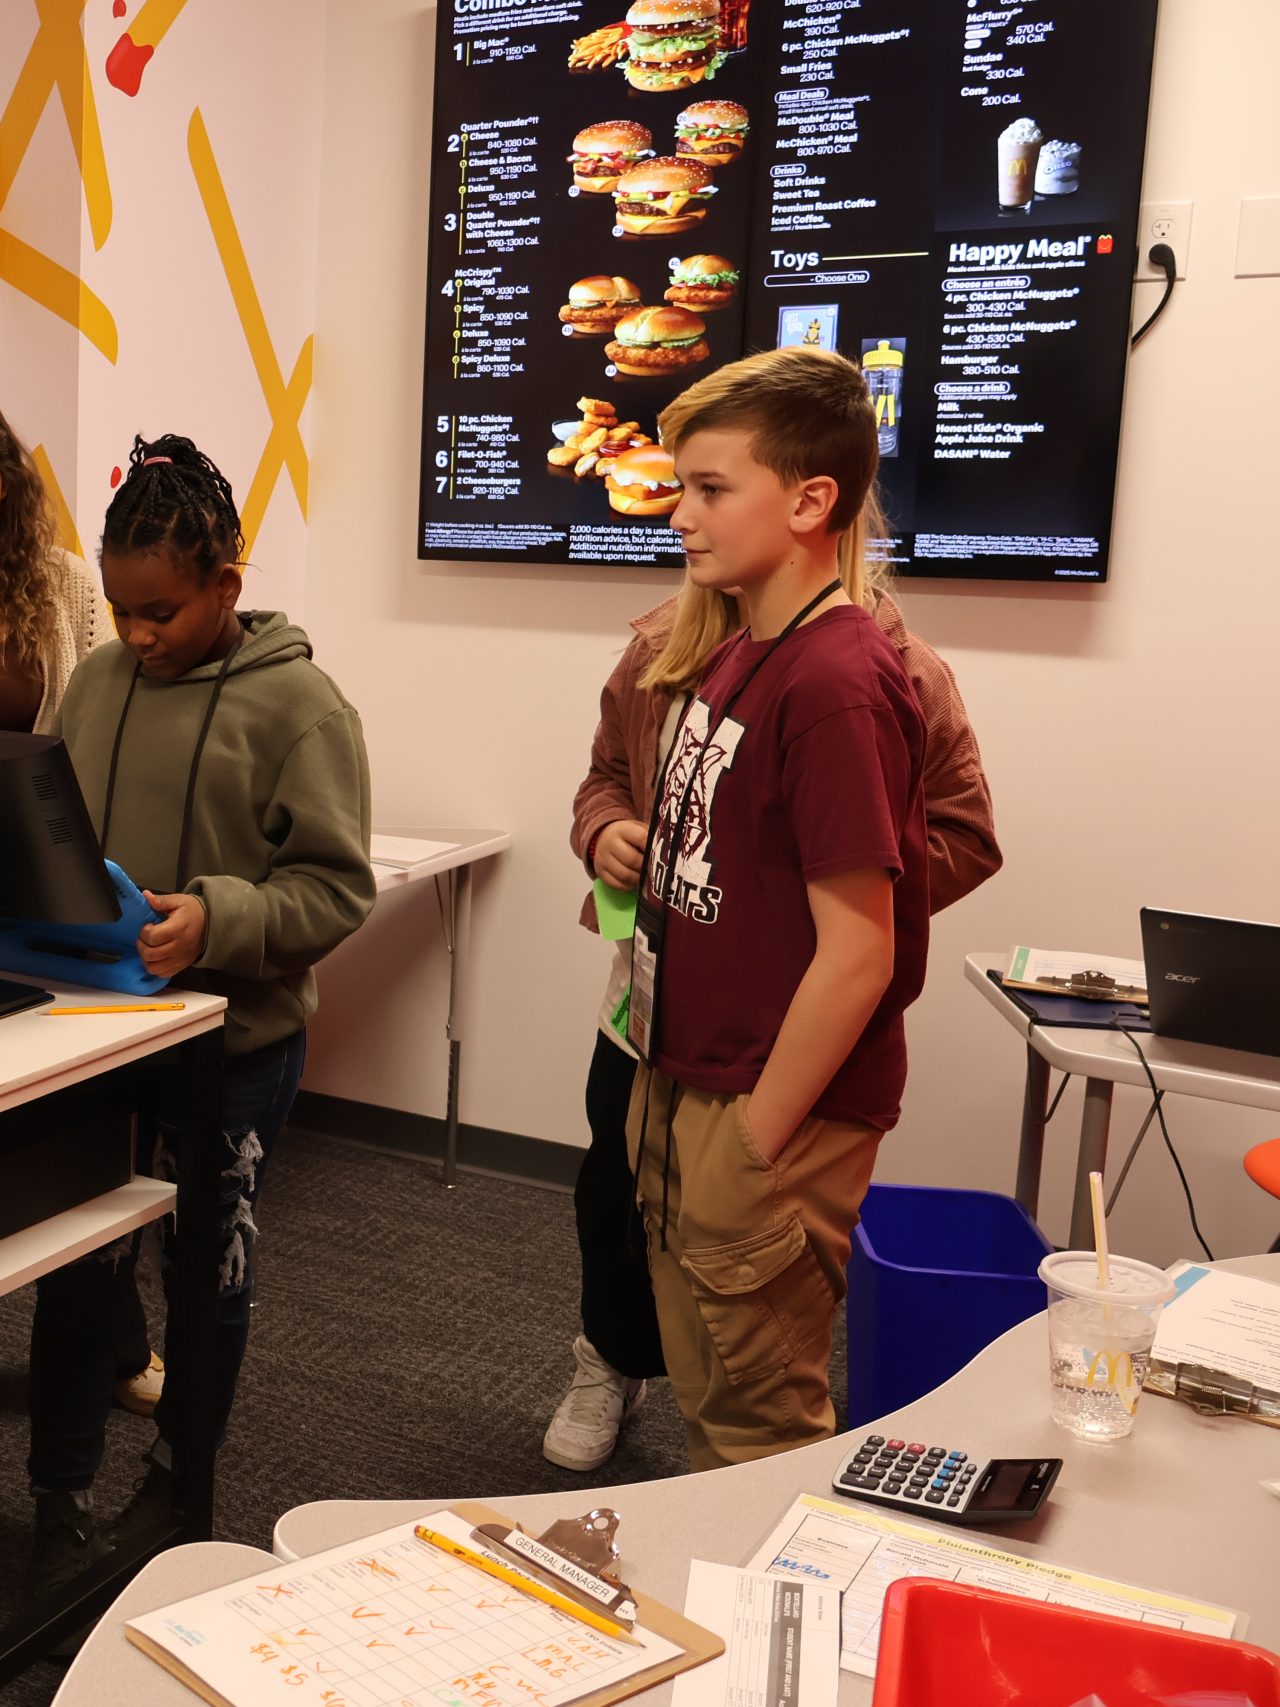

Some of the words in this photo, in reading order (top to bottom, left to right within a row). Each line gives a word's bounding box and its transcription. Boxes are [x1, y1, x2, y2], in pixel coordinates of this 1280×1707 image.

[804, 26, 821, 36] 390
[822, 25, 839, 34] Cal.
[1016, 25, 1034, 34] 570
[1035, 22, 1054, 32] Cal.
[1006, 36, 1026, 45] 340
[1026, 33, 1046, 42] Cal.
[474, 41, 486, 50] Big
[490, 47, 521, 57] 910-1150
[522, 44, 536, 54] Cal.
[782, 43, 789, 52] 6
[789, 44, 803, 53] pc.
[804, 38, 843, 49] Chicken
[454, 43, 462, 60] 1
[803, 49, 820, 59] 250
[821, 48, 838, 57] Cal.
[963, 53, 1003, 64] Sundae
[781, 64, 807, 74] Small
[808, 61, 832, 72] Fries
[986, 70, 1005, 79] 330
[1006, 67, 1025, 77] Cal.
[800, 72, 817, 82] 230
[818, 71, 835, 80] Cal.
[779, 92, 799, 101] Meal
[800, 90, 824, 99] Deals
[961, 87, 989, 96] Cone
[982, 96, 1001, 106] 200
[1002, 94, 1021, 104] Cal.
[831, 111, 854, 121] Meal
[460, 122, 492, 132] Quarter
[798, 122, 839, 134] 800-1030
[840, 121, 858, 130] Cal.
[470, 132, 499, 140] Cheese
[834, 133, 858, 143] Meal
[447, 134, 459, 152] 2
[487, 139, 521, 149] 840-1080
[523, 137, 537, 146] Cal.
[797, 146, 833, 157] 800-970
[834, 144, 851, 153] Cal.
[469, 158, 498, 166] Cheese
[499, 156, 505, 164] &
[507, 155, 532, 163] Bacon
[490, 165, 522, 175] 950-1190
[523, 164, 537, 172] Cal.
[774, 167, 802, 175] Drinks
[774, 179, 794, 188] Soft
[795, 176, 826, 186] Drinks
[468, 184, 495, 192] Deluxe
[773, 191, 802, 200] Sweet
[803, 189, 820, 198] Tea
[772, 203, 814, 213] Premium
[815, 201, 843, 211] Roast
[844, 199, 876, 208] Coffee
[467, 211, 495, 220] Double
[771, 216, 792, 225] Iced
[793, 214, 824, 224] Coffee
[444, 214, 456, 231] 3
[466, 221, 496, 230] Quarter
[949, 243, 1024, 265] Happy
[771, 250, 819, 271] Toys
[464, 278, 495, 287] Original
[815, 274, 847, 282] Choose
[848, 273, 865, 281] One
[441, 280, 454, 296] 4
[946, 280, 981, 289] Choose
[995, 278, 1025, 287] entrée
[482, 287, 515, 295] 790-1030
[515, 286, 530, 294] Cal.
[945, 293, 953, 302] 4
[954, 295, 968, 304] pc.
[970, 292, 1012, 301] Chicken
[463, 304, 485, 313] Spicy
[966, 303, 1006, 312] 300-430
[1007, 302, 1026, 311] Cal.
[480, 313, 513, 321] 850-1090
[514, 312, 528, 320] Cal.
[943, 325, 950, 334] 6
[951, 326, 966, 335] pc.
[967, 323, 1009, 333] Chicken
[966, 334, 1006, 344] 430-530
[1006, 334, 1025, 342] Cal.
[461, 355, 482, 364] Spicy
[941, 355, 999, 366] Hamburger
[962, 366, 1000, 375] 380-510
[1001, 365, 1020, 374] Cal.
[939, 385, 973, 393] Choose
[981, 384, 1006, 392] drink
[937, 402, 959, 411] Milk
[437, 416, 449, 432] 5
[469, 416, 480, 424] pc.
[936, 424, 972, 433] Honest
[1003, 423, 1044, 435] Organic
[935, 434, 964, 445] Apple
[965, 434, 993, 443] Juice
[995, 434, 1023, 443] Drink
[436, 450, 448, 467] 6
[980, 450, 1011, 458] Water
[436, 477, 447, 493] 7
[463, 477, 521, 486] Cheeseburgers
[570, 525, 591, 533] 2,000
[592, 526, 621, 534] calories
[630, 526, 644, 536] day
[570, 534, 602, 542] nutrition
[604, 535, 631, 543] advice,
[646, 536, 673, 544] calorie
[569, 543, 608, 551] Additional
[569, 552, 602, 560] available
[603, 553, 623, 561] upon
[625, 553, 656, 562] request.
[1164, 972, 1201, 984] acer
[480, 1549, 509, 1568] Lunch
[938, 1537, 1022, 1566] Philanthropy
[1026, 1562, 1072, 1581] Pledge
[515, 1537, 558, 1567] GENERAL
[559, 1563, 610, 1598] MANAGER
[785, 1647, 793, 1659] NAME
